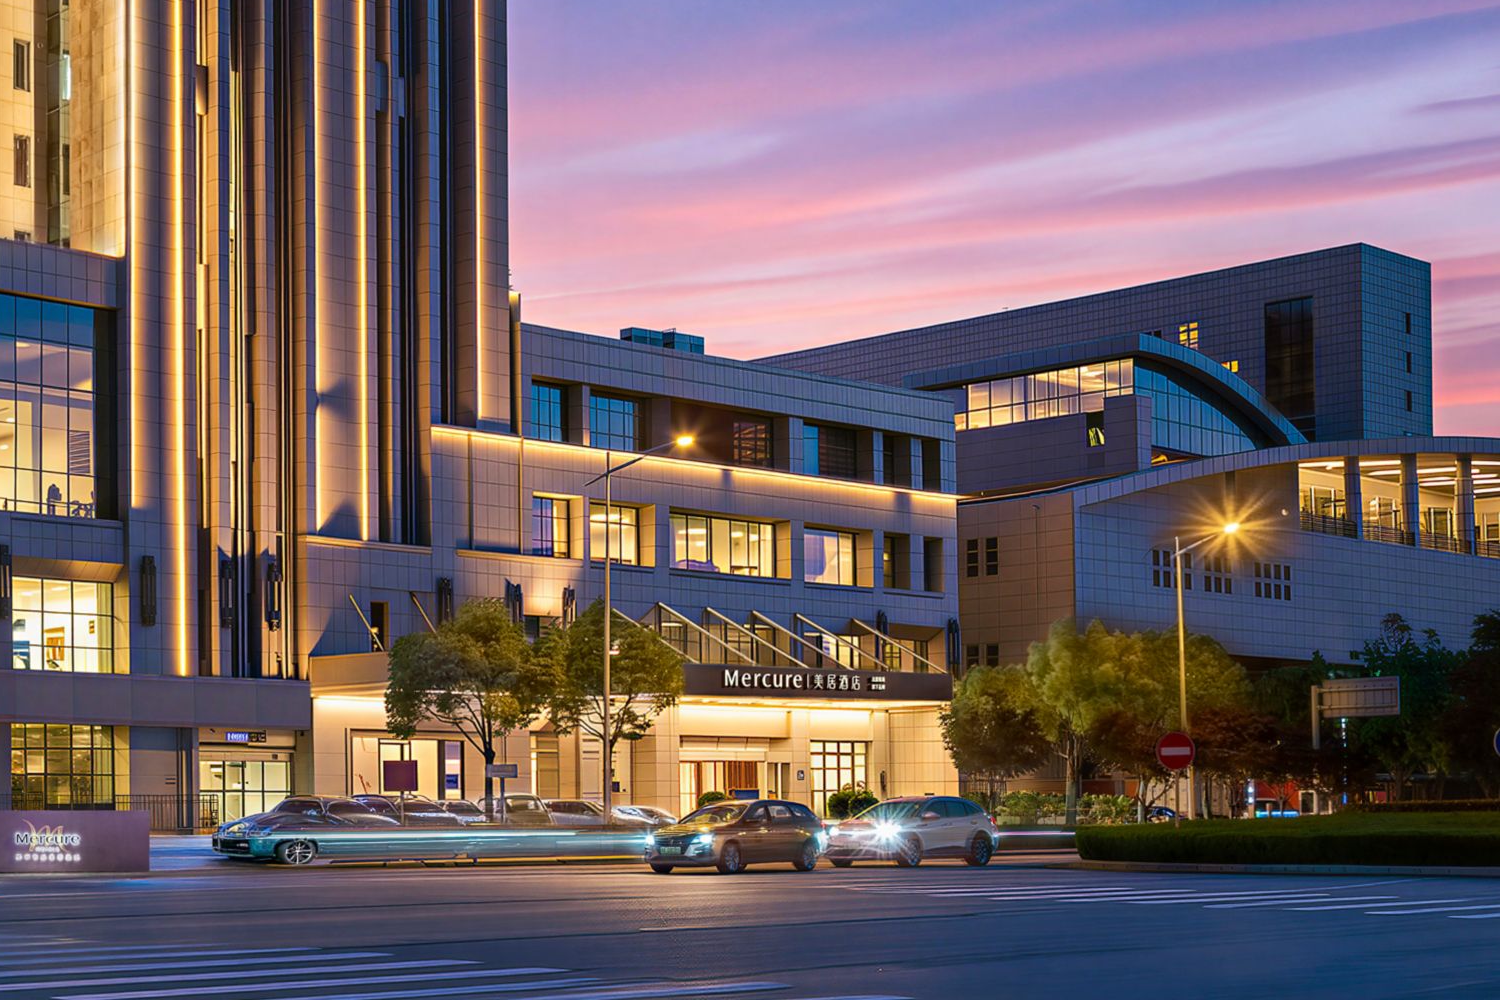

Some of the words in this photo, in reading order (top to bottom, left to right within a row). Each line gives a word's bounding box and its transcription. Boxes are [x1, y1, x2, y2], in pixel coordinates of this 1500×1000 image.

[724, 670, 802, 688] Mercure
[813, 674, 861, 691] 美居酒店
[15, 831, 82, 846] Mercure
